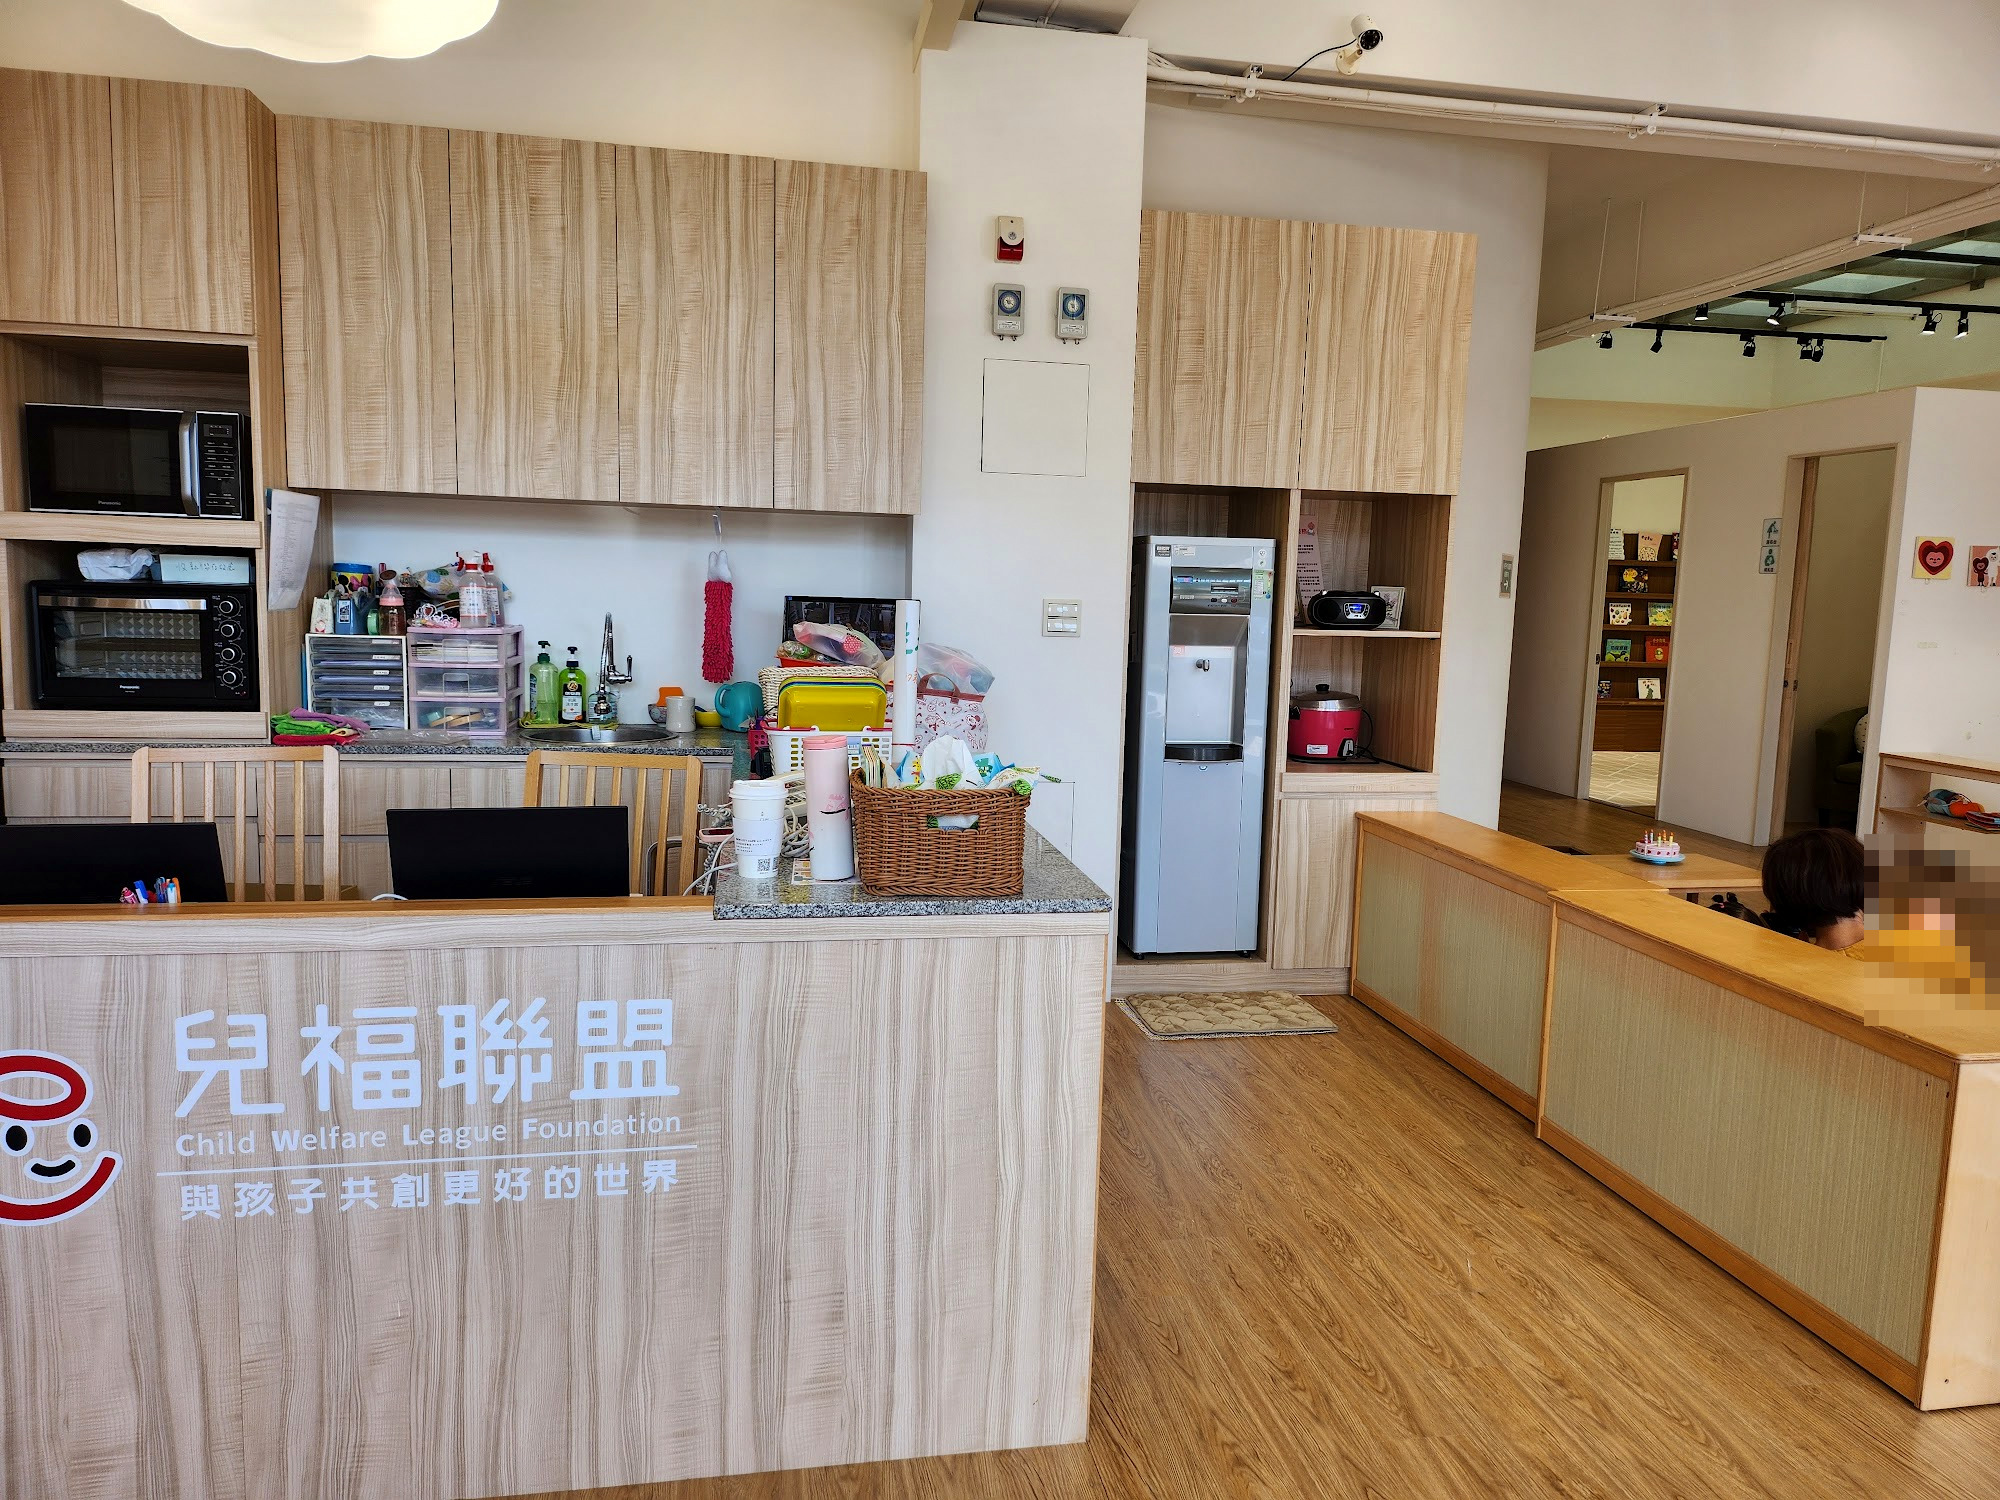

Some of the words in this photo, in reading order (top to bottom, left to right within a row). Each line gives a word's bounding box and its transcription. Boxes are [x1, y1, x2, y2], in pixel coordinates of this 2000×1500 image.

[174, 997, 681, 1118] 兒福聯盟
[175, 1129, 256, 1157] Child
[271, 1125, 387, 1152] Welfare
[403, 1124, 508, 1150] League
[522, 1111, 682, 1140] Foundation
[180, 1159, 680, 1221] 與孩子共創更好的世界
